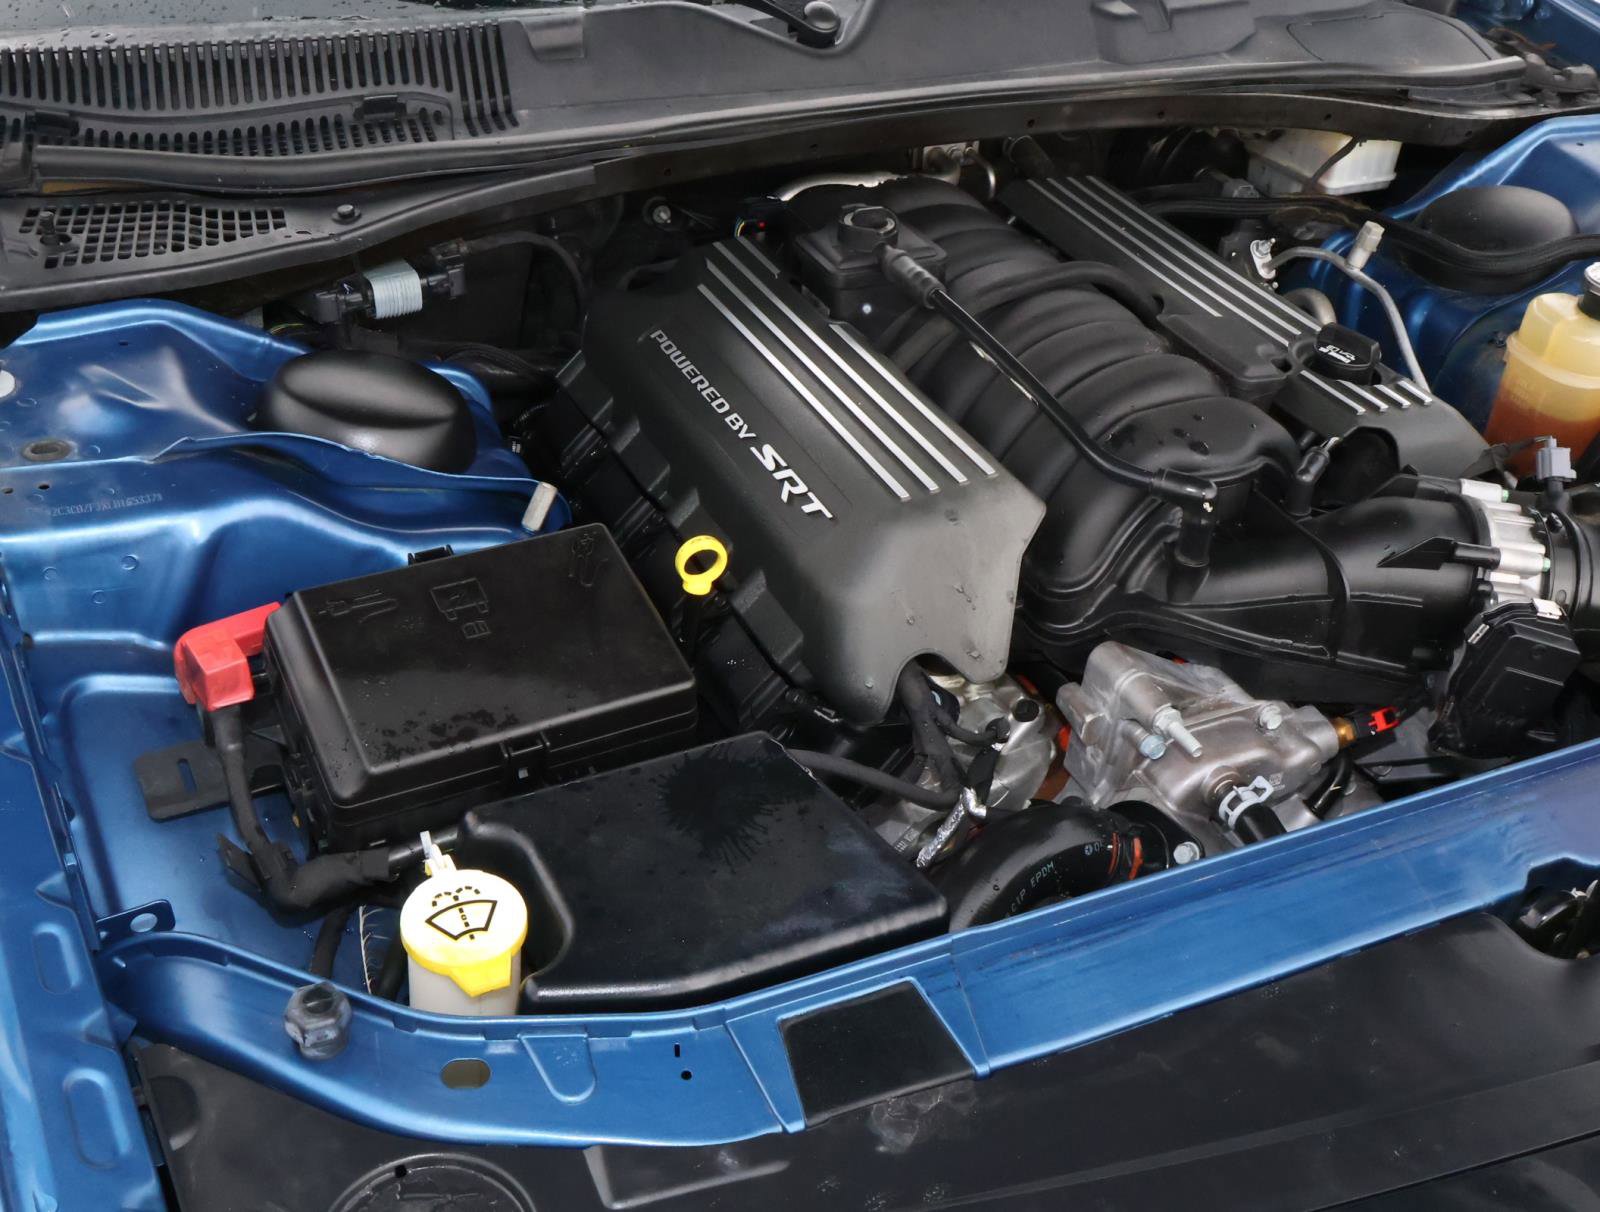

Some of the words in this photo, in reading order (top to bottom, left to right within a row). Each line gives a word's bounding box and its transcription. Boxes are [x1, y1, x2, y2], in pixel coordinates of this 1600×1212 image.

[650, 329, 730, 414] POWERED
[724, 412, 757, 439] BY
[749, 443, 834, 519] SRT
[1030, 860, 1054, 888] EPDM
